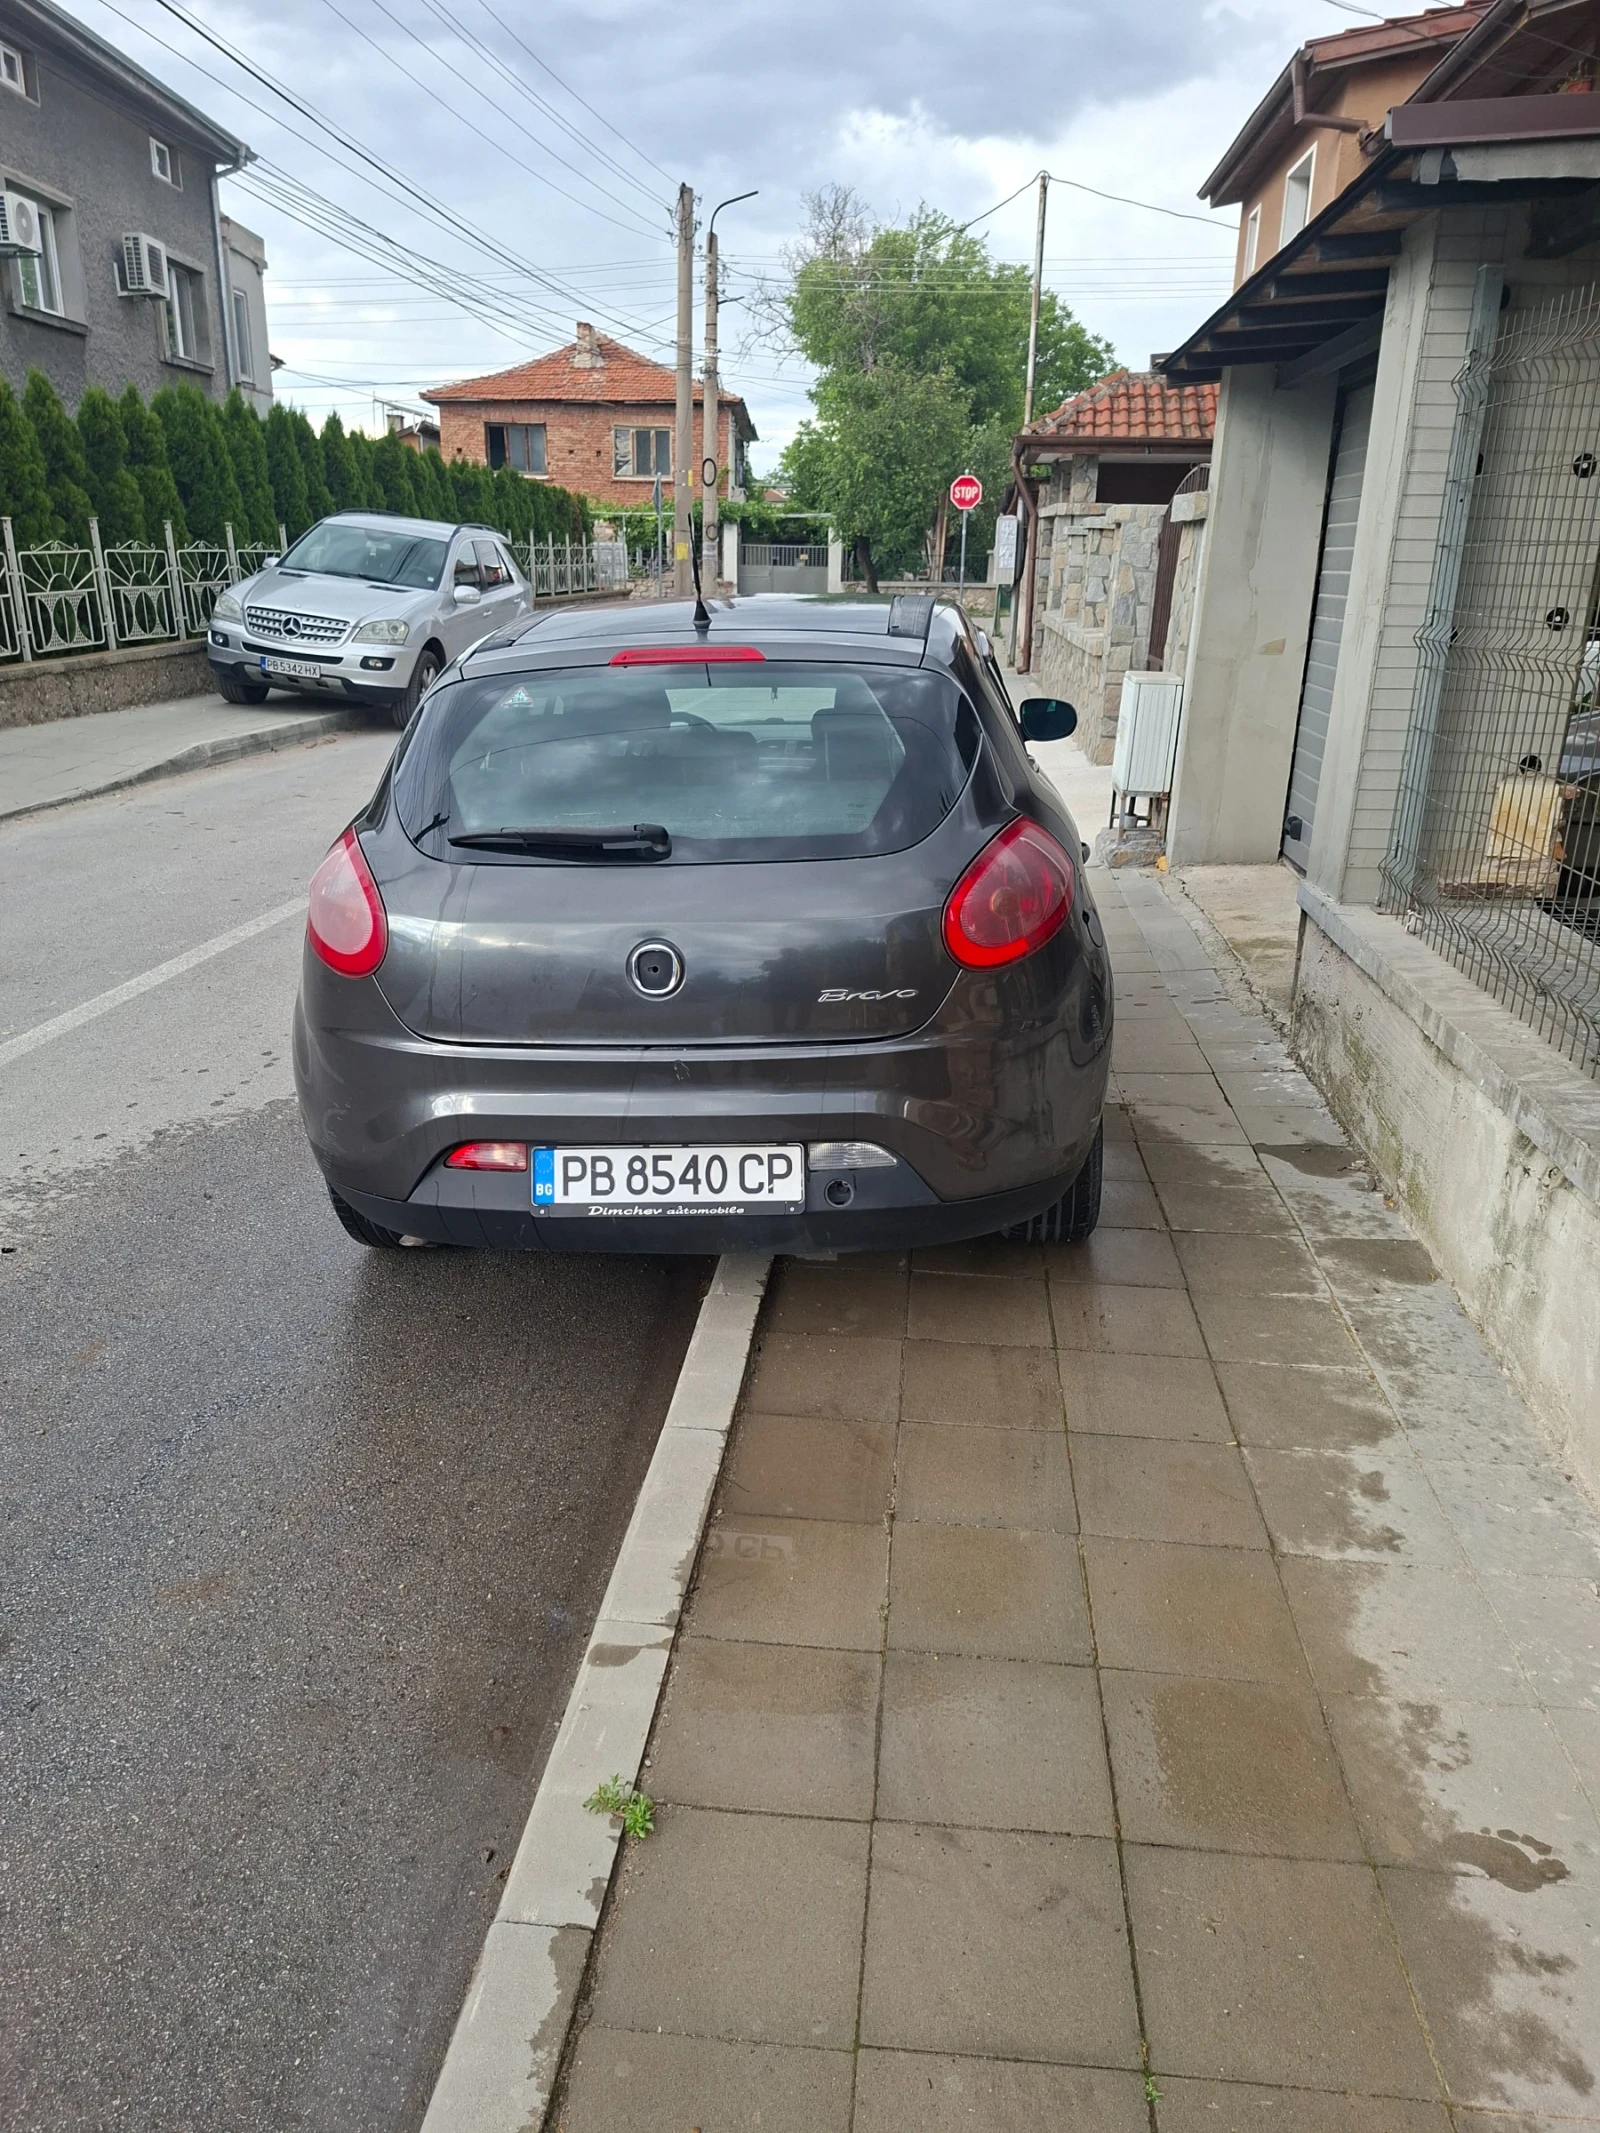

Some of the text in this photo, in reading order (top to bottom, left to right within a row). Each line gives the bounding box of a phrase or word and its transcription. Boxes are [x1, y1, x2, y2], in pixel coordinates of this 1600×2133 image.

[954, 486, 979, 499] STOP
[267, 659, 279, 670] PB
[280, 661, 303, 674] 5342
[305, 666, 318, 677] HX
[818, 989, 918, 1002] Bravo
[562, 1153, 793, 1196] PB 8540 CP
[536, 1183, 553, 1196] BG
[587, 1204, 745, 1216] Dimchev automobile
